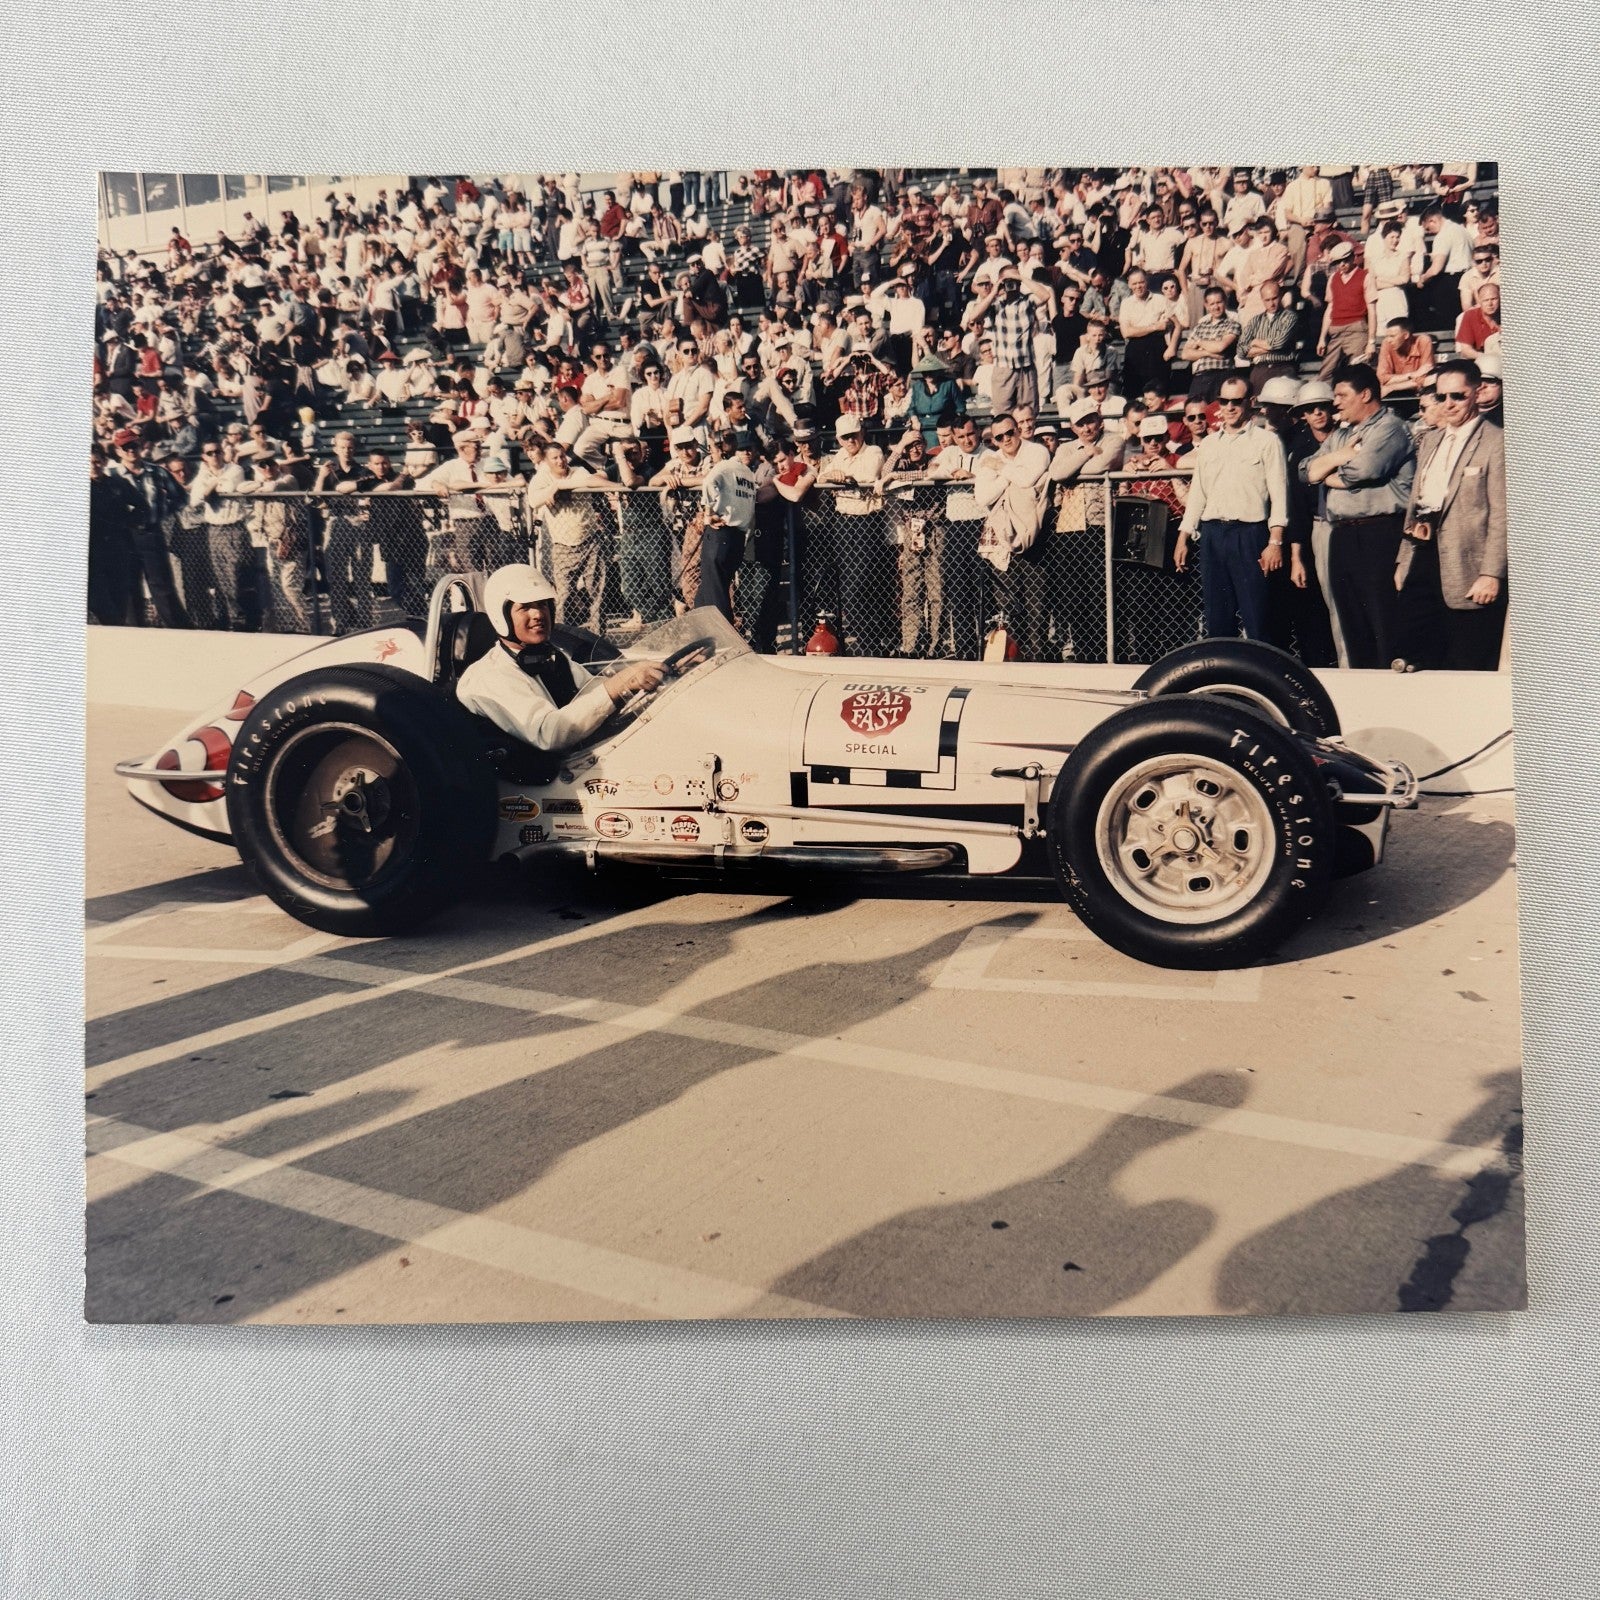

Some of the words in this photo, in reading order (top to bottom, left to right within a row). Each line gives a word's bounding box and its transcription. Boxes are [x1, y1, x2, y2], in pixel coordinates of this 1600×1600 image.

[843, 683, 929, 694] BOWES
[852, 691, 904, 707] SEAL
[851, 707, 903, 732] FAST
[232, 693, 327, 785] Firestone
[845, 743, 897, 755] SPECIAL
[586, 784, 618, 796] BEAR
[1230, 728, 1313, 889] Firestone
[1243, 760, 1277, 794] DELUXE
[1276, 801, 1294, 856] CHAMPION
